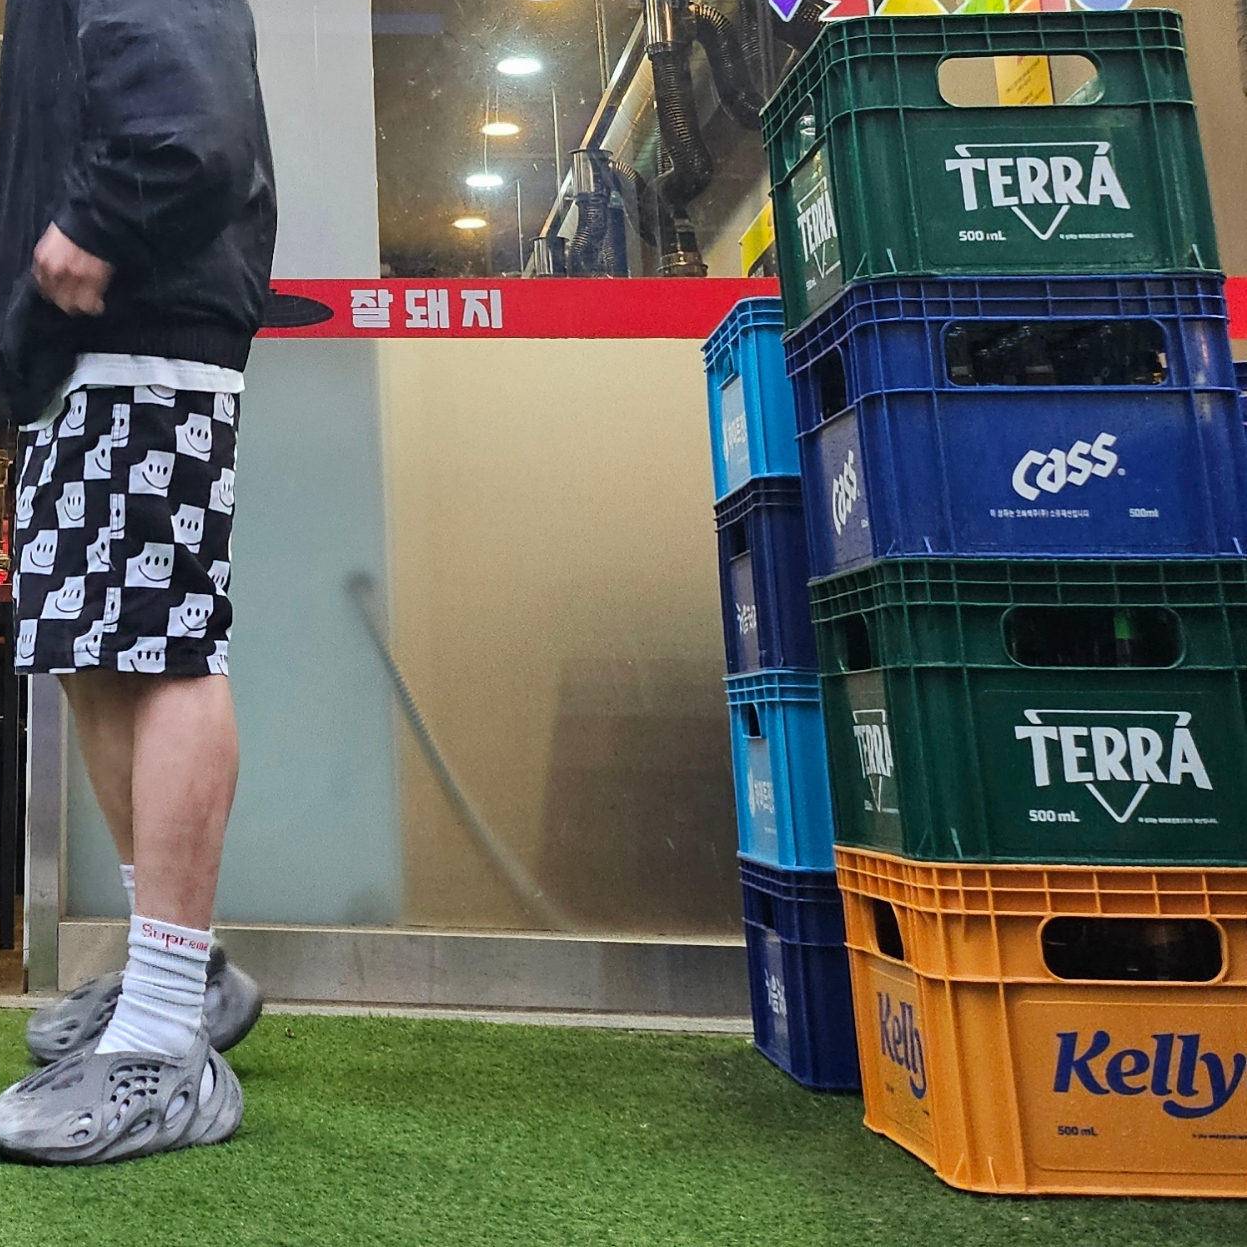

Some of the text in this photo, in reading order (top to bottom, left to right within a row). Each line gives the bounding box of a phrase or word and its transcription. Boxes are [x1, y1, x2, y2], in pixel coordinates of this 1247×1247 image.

[945, 154, 1131, 211] TERRA
[797, 190, 838, 263] TERRA
[853, 724, 894, 779] TERRA
[1015, 725, 1213, 791] TERRA
[877, 991, 927, 1100] Kelly
[1055, 1031, 1247, 1119] Kelly
